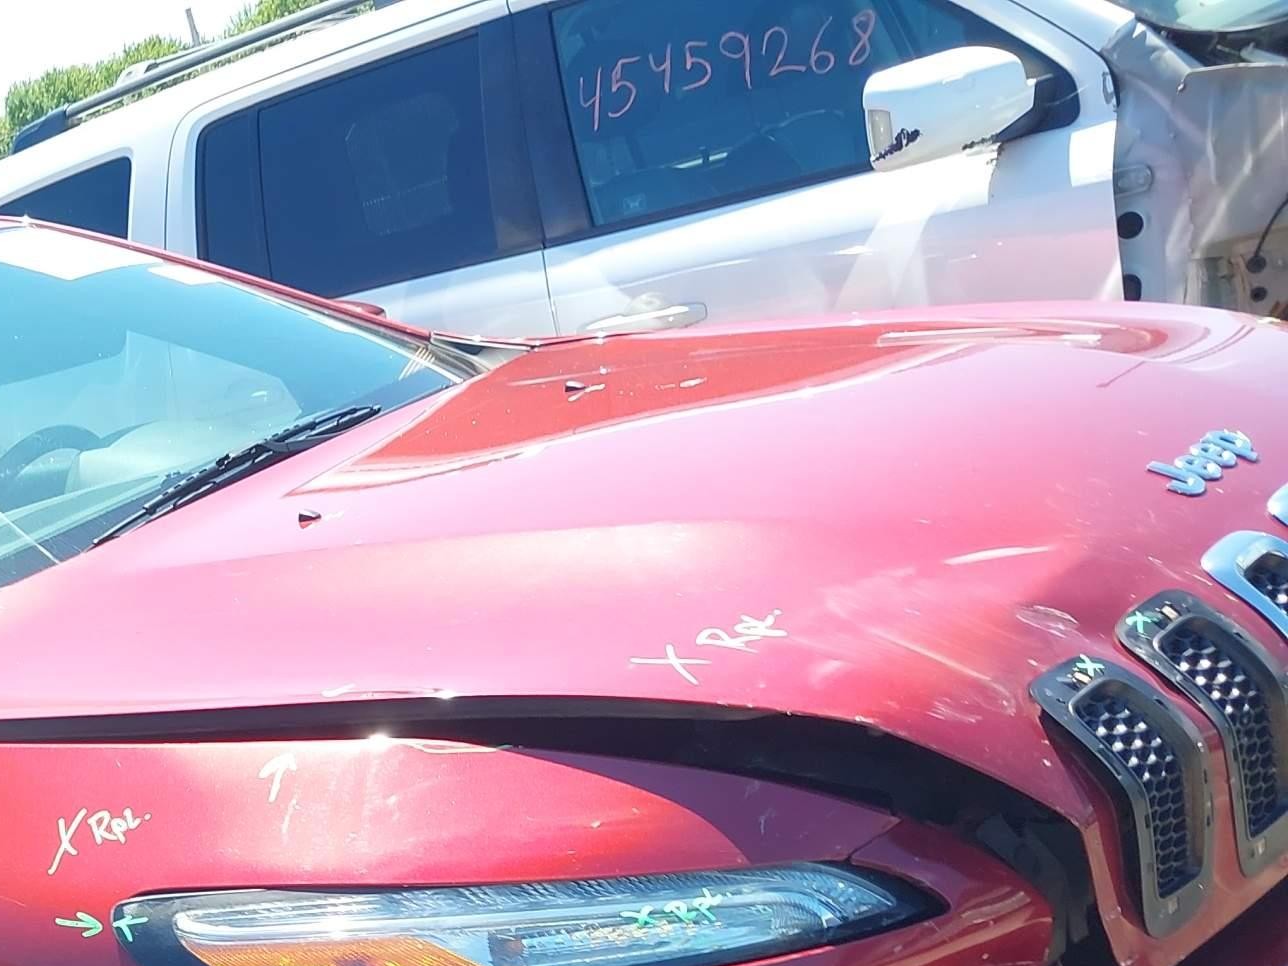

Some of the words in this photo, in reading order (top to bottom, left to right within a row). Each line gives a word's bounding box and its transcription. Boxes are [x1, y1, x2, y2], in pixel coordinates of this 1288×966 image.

[579, 9, 877, 132] 45459268
[1146, 429, 1258, 496] Jeep
[630, 643, 712, 686] X
[48, 807, 88, 875] X
